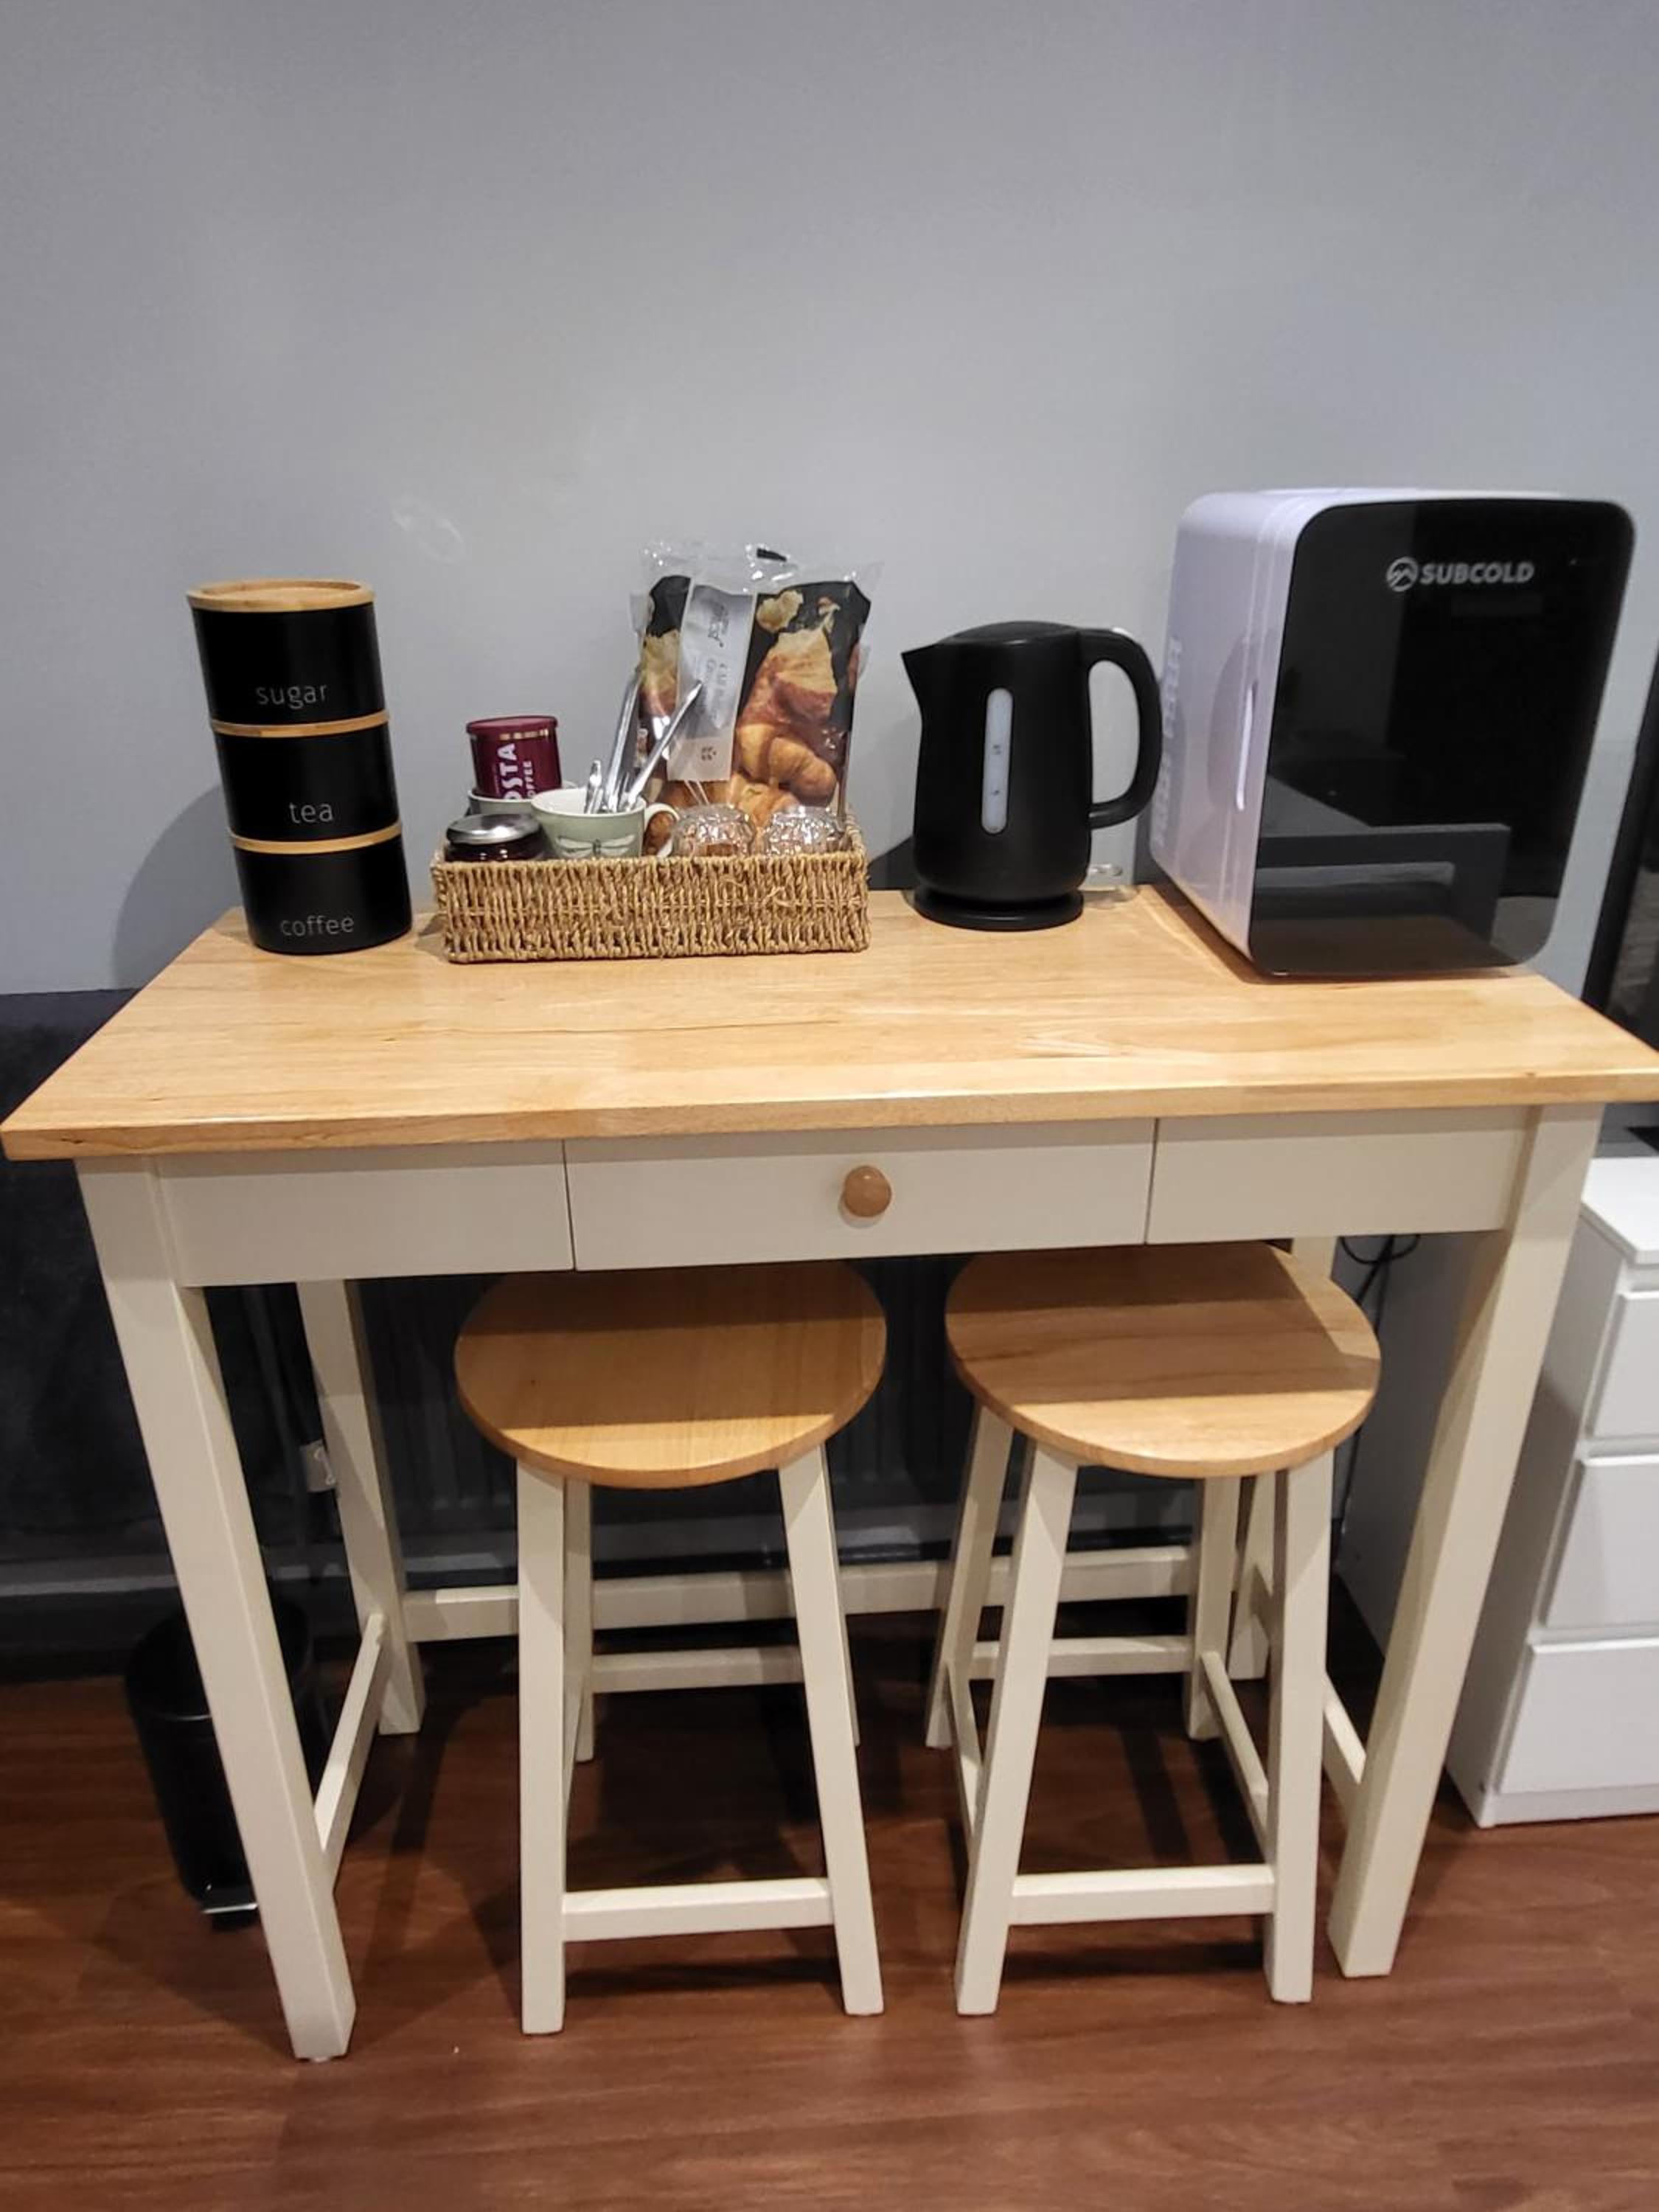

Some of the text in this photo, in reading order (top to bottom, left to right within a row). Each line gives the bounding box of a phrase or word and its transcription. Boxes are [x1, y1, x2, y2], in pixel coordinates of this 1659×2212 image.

[1419, 562, 1535, 585] SUBCOLD
[255, 684, 327, 709] sugar
[497, 742, 524, 799] OSTA
[522, 760, 536, 797] OFFEE
[288, 802, 333, 824] tea
[279, 915, 355, 937] coffee
